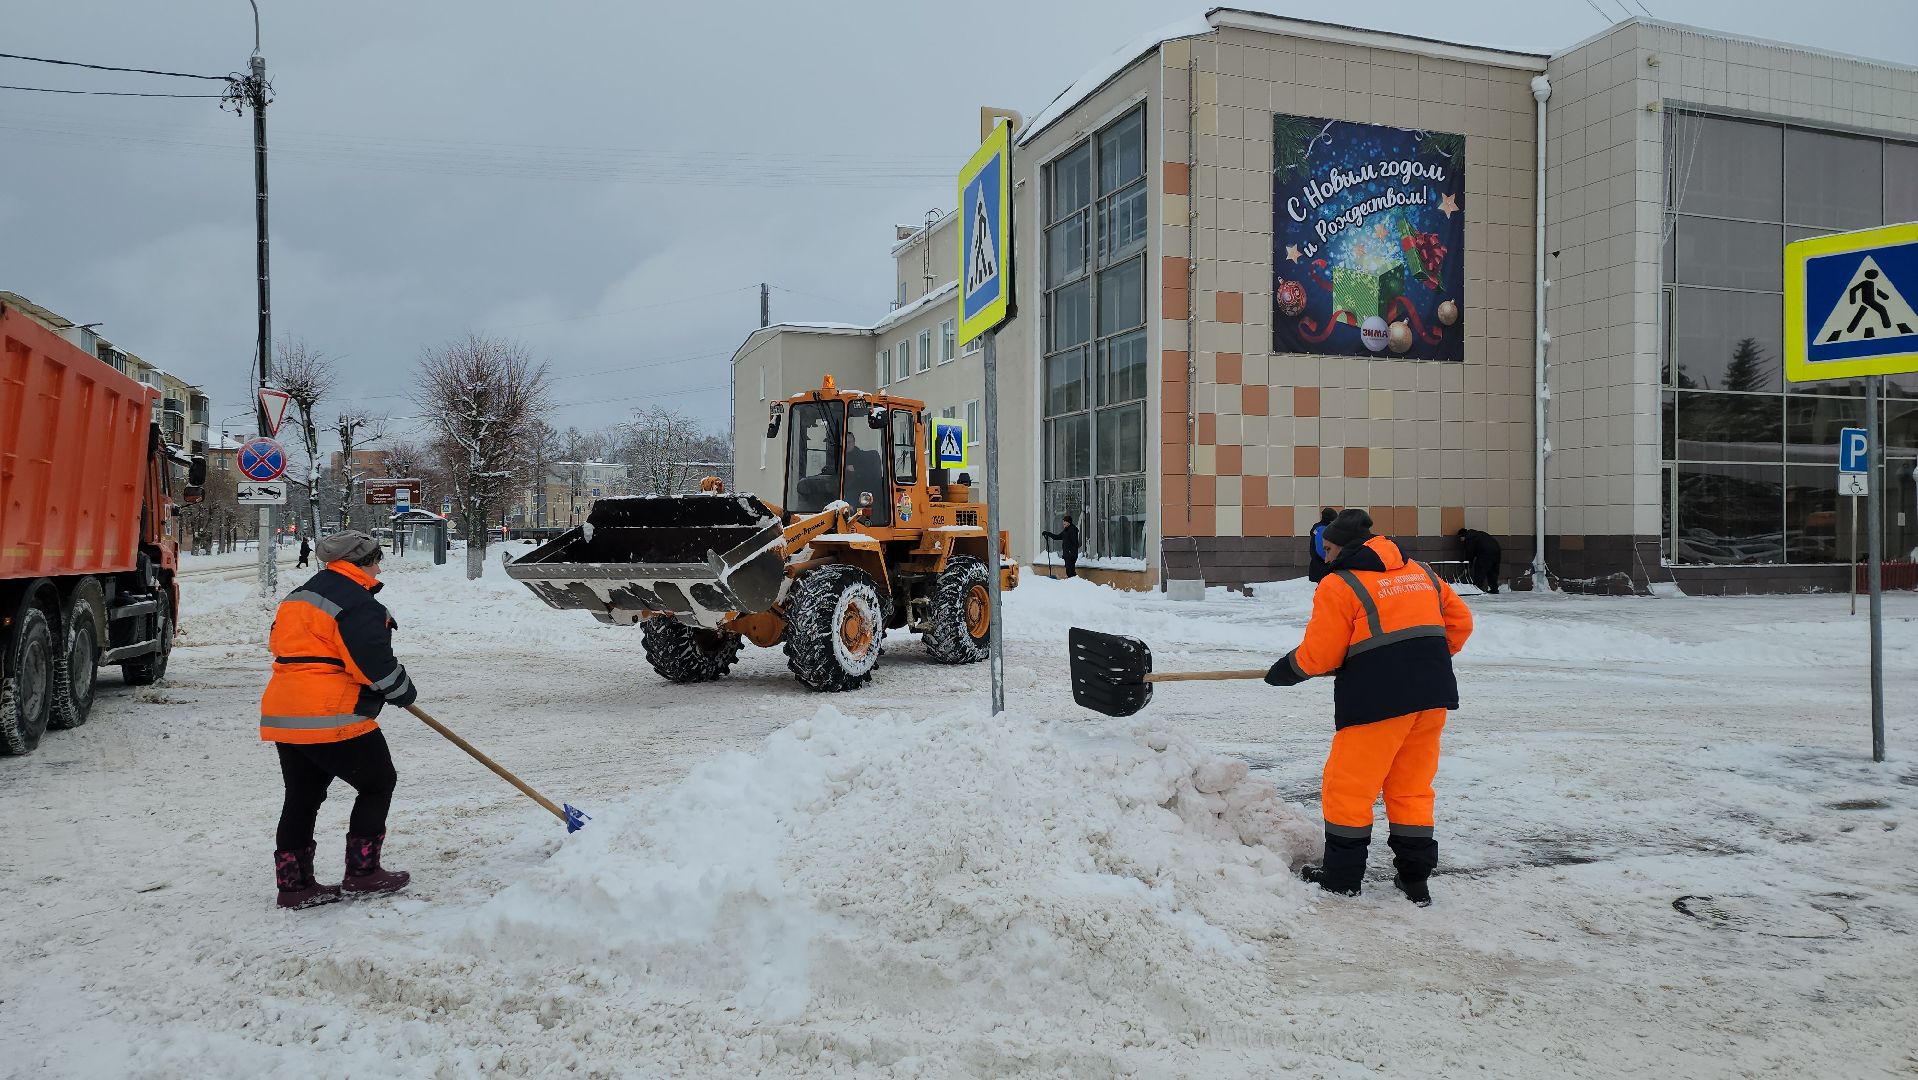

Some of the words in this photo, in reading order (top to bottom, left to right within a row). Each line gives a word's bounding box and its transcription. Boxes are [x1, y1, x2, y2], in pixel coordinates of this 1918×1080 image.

[1287, 197, 1307, 222] С
[1303, 163, 1378, 208] Новым
[1379, 160, 1446, 186] годом
[1303, 242, 1318, 258] и
[1314, 185, 1427, 243] Рождеством!
[1362, 328, 1389, 338] ЗИМА
[1850, 434, 1867, 468] P
